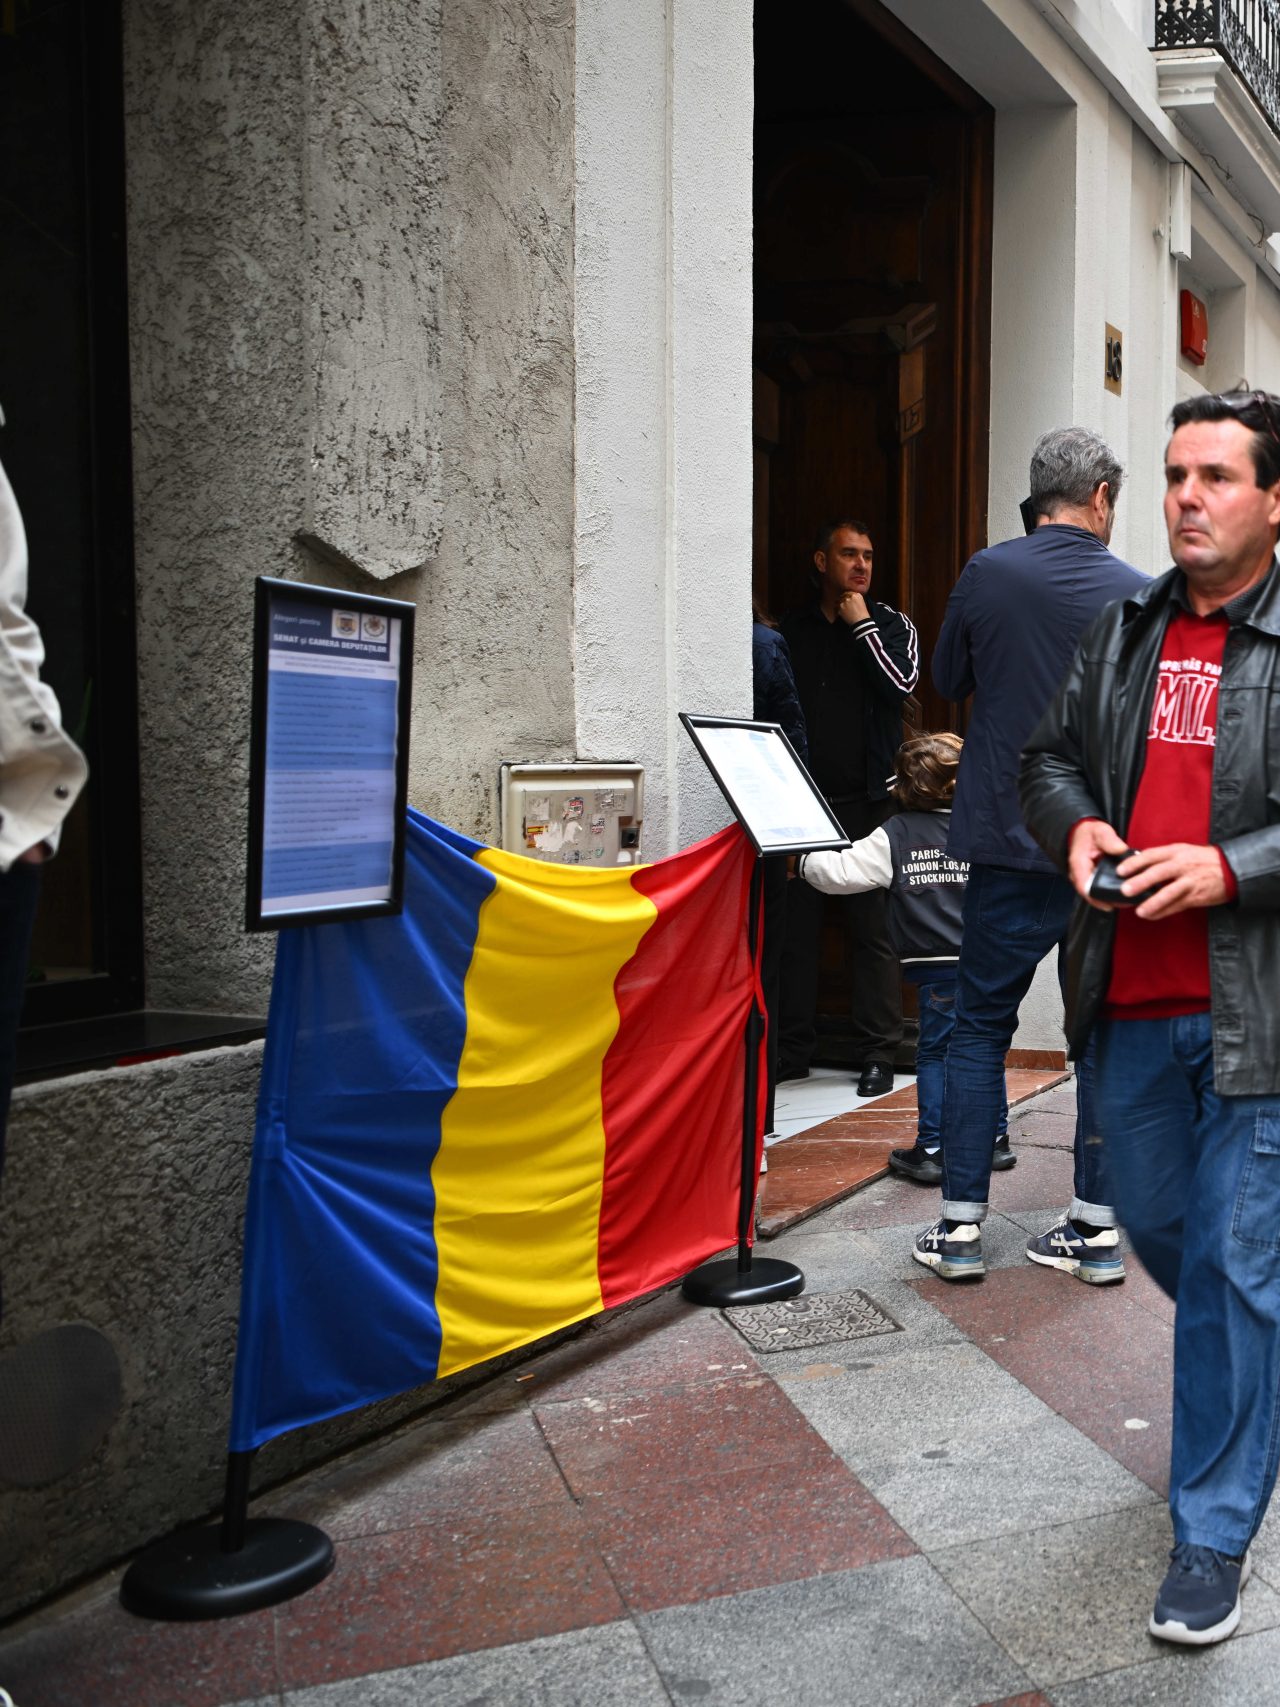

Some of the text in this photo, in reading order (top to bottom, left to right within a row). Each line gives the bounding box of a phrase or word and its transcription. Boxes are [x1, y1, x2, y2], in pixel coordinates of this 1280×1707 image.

[1106, 336, 1122, 382] 18
[273, 633, 299, 643] SENAT
[308, 638, 340, 648] CAMERA
[1147, 672, 1219, 747] MIL
[911, 849, 951, 860] PARIS-
[902, 861, 959, 874] LONDON-LOS
